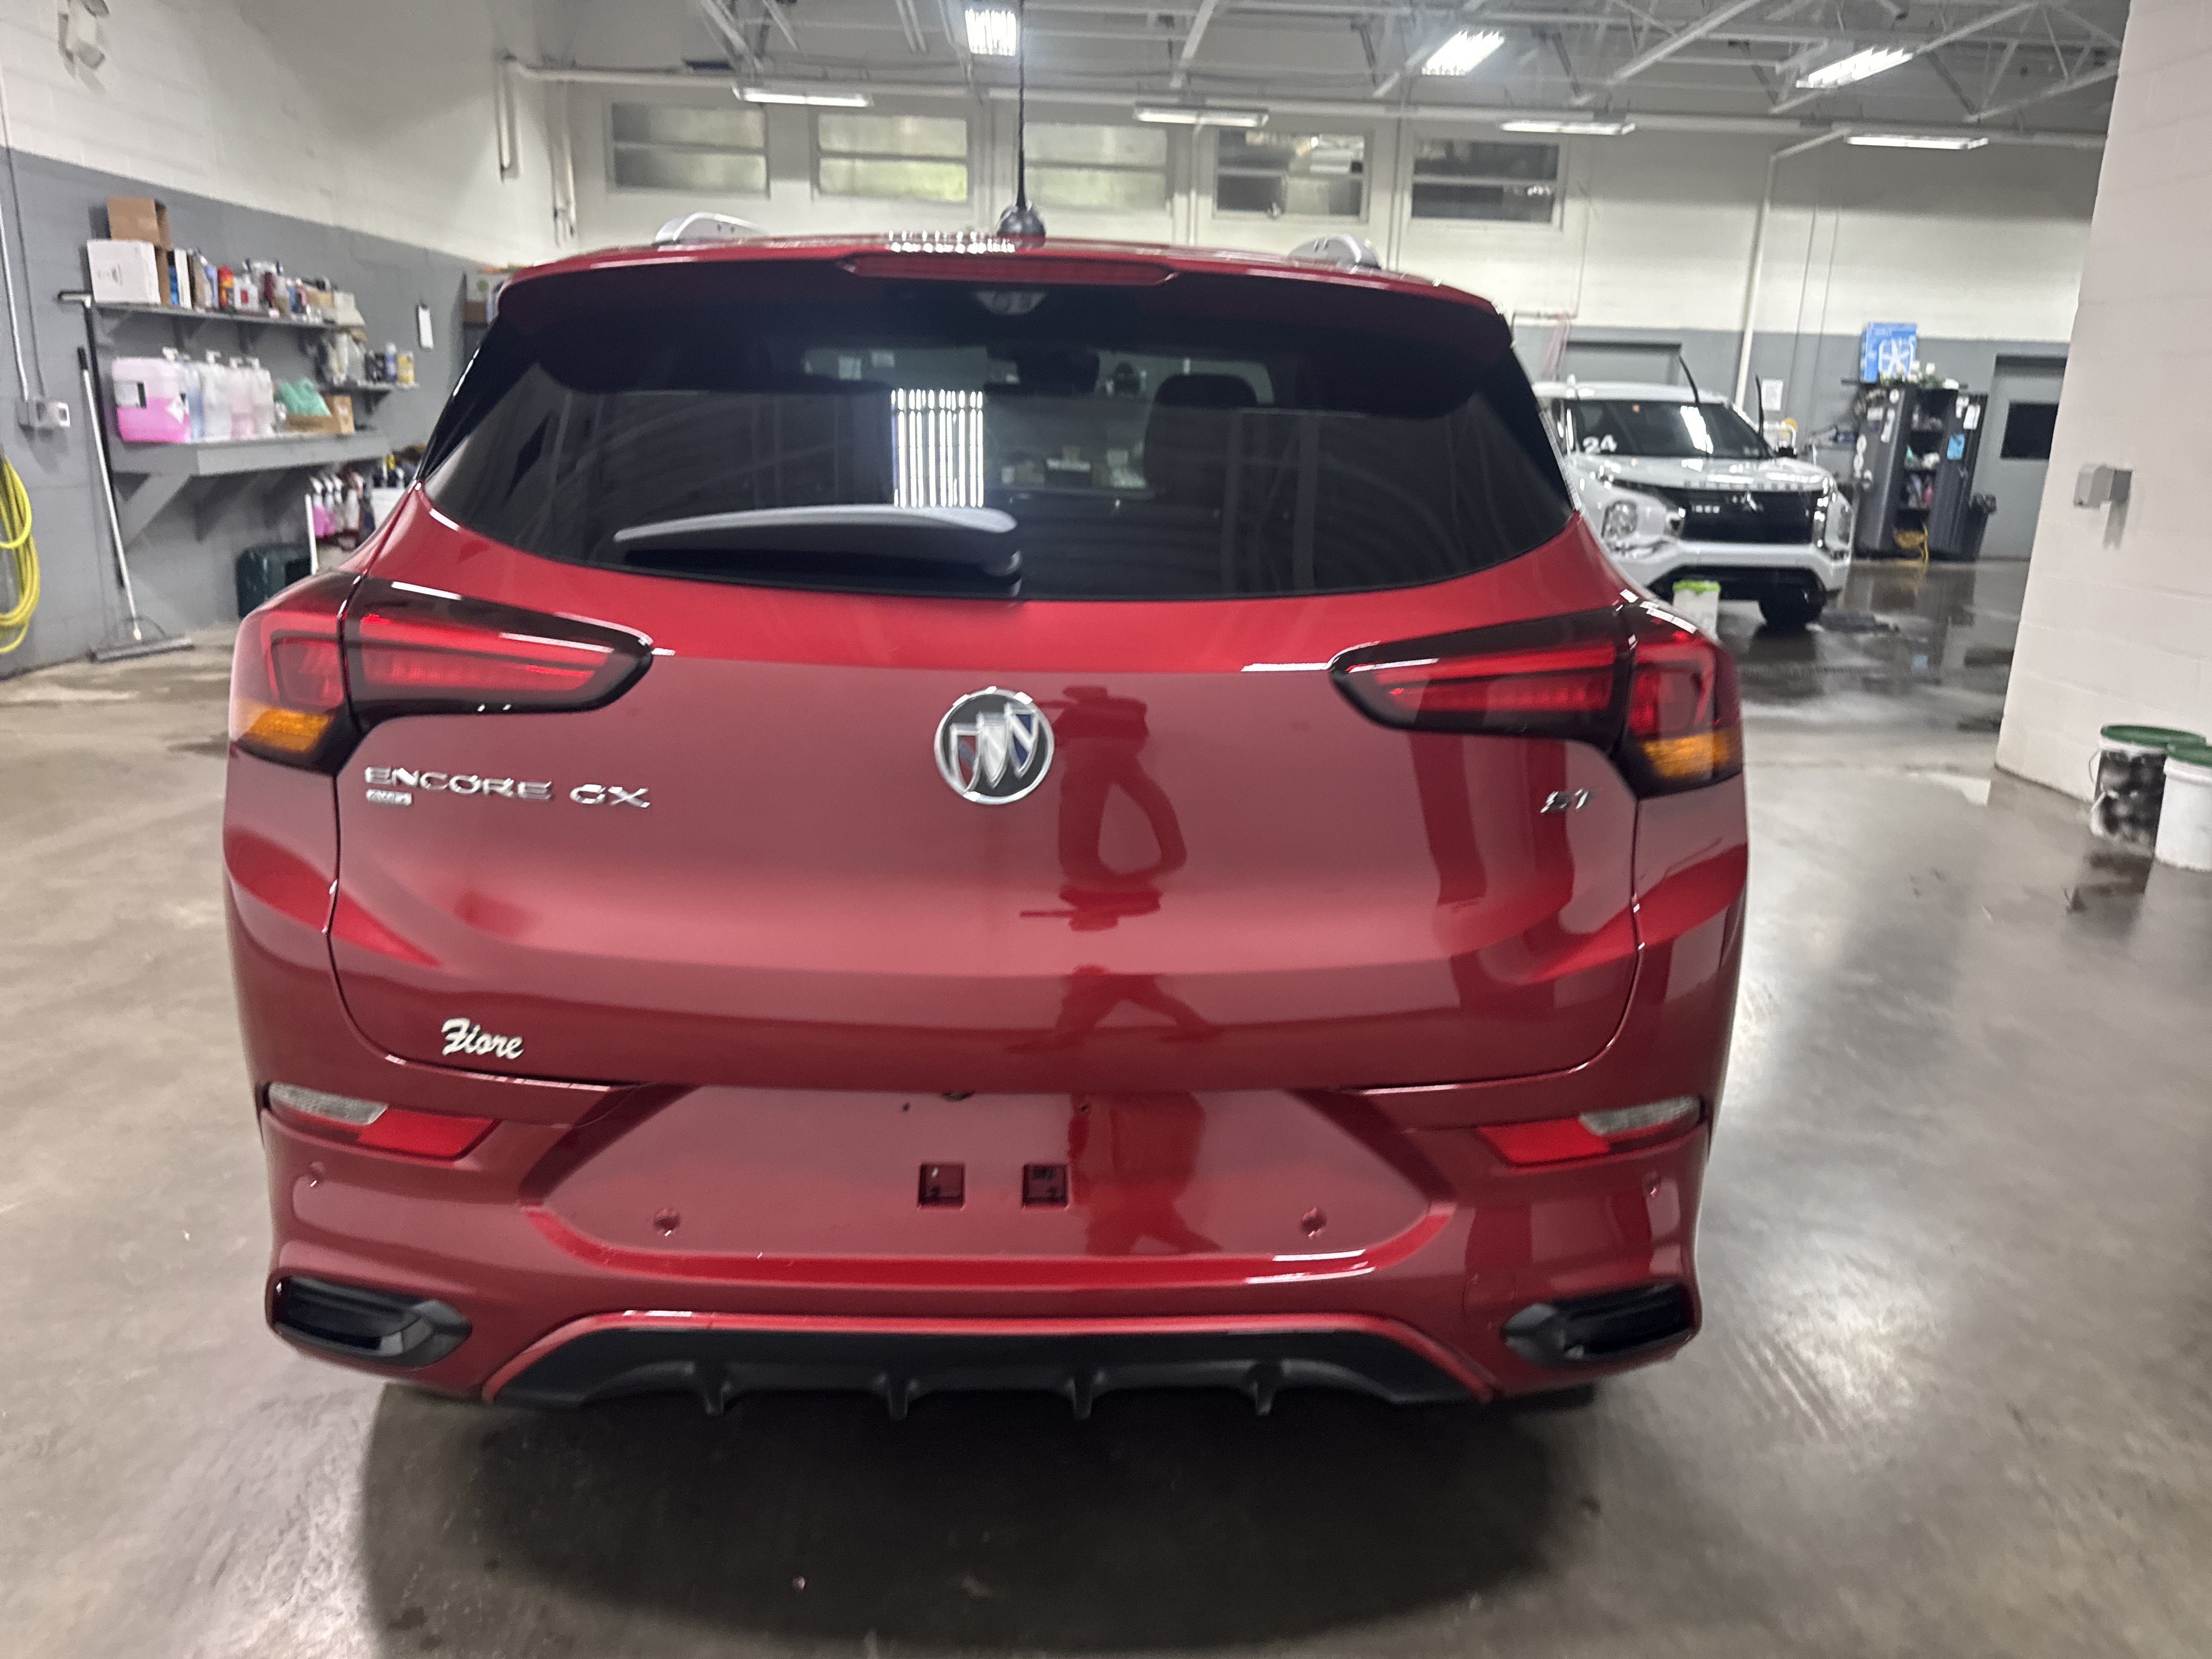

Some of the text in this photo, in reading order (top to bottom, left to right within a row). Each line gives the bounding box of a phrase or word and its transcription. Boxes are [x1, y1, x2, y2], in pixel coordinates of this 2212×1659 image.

[364, 767, 552, 800] ENCORE
[569, 784, 651, 808] GX
[441, 1017, 524, 1059] Fiore
